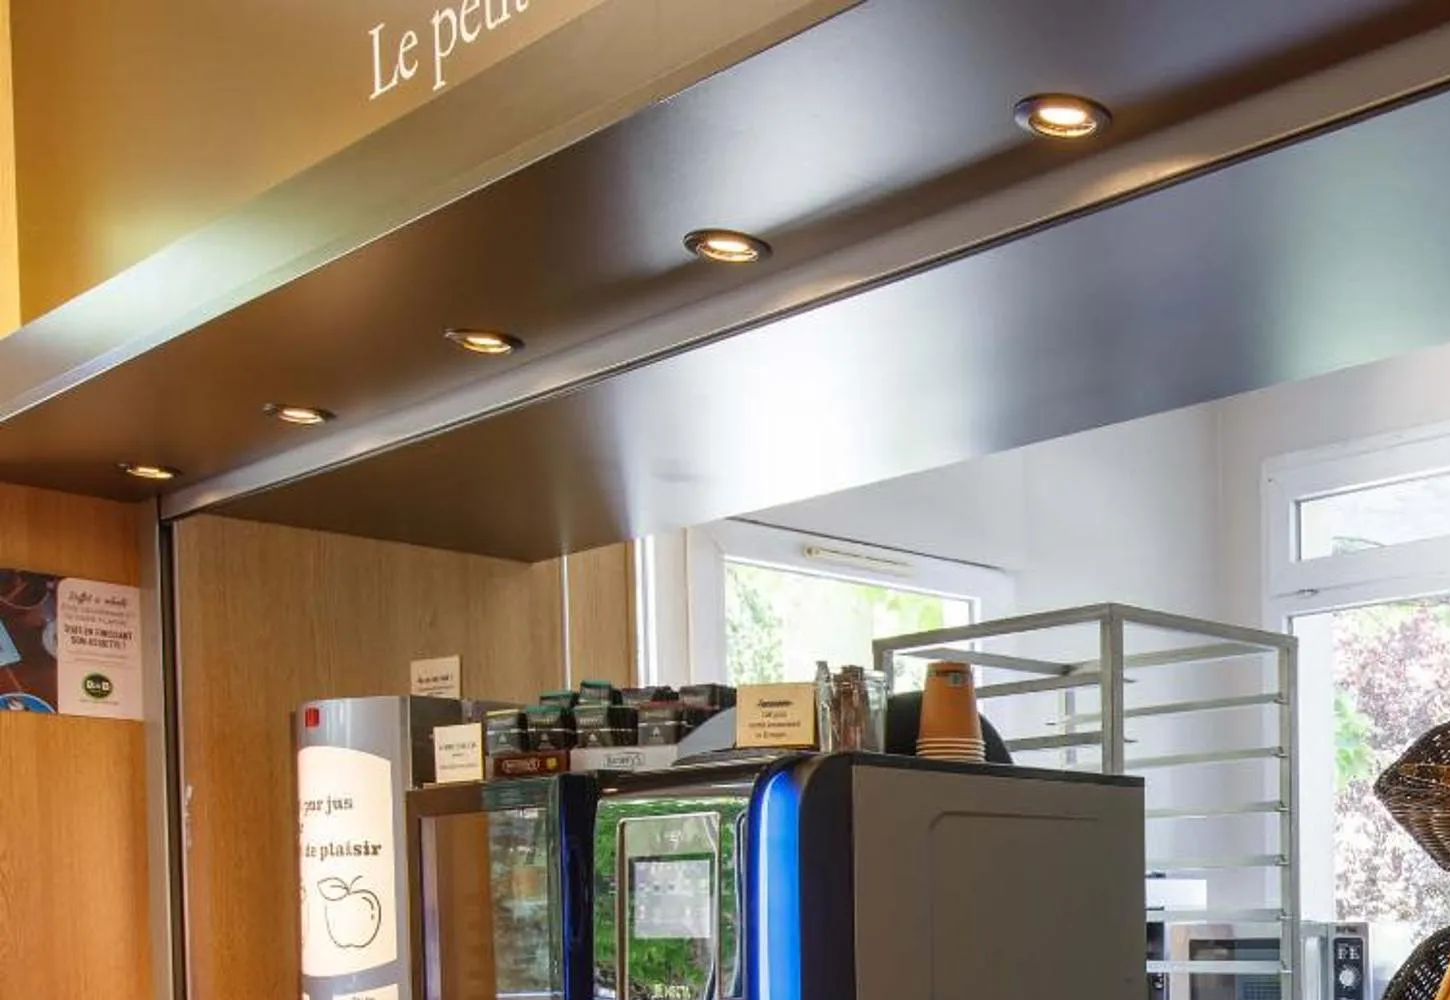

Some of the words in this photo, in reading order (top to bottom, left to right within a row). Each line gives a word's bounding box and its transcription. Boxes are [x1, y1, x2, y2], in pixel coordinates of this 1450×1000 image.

[368, 22, 419, 101] Le
[325, 794, 353, 816] jus
[319, 841, 382, 862] plaisir
